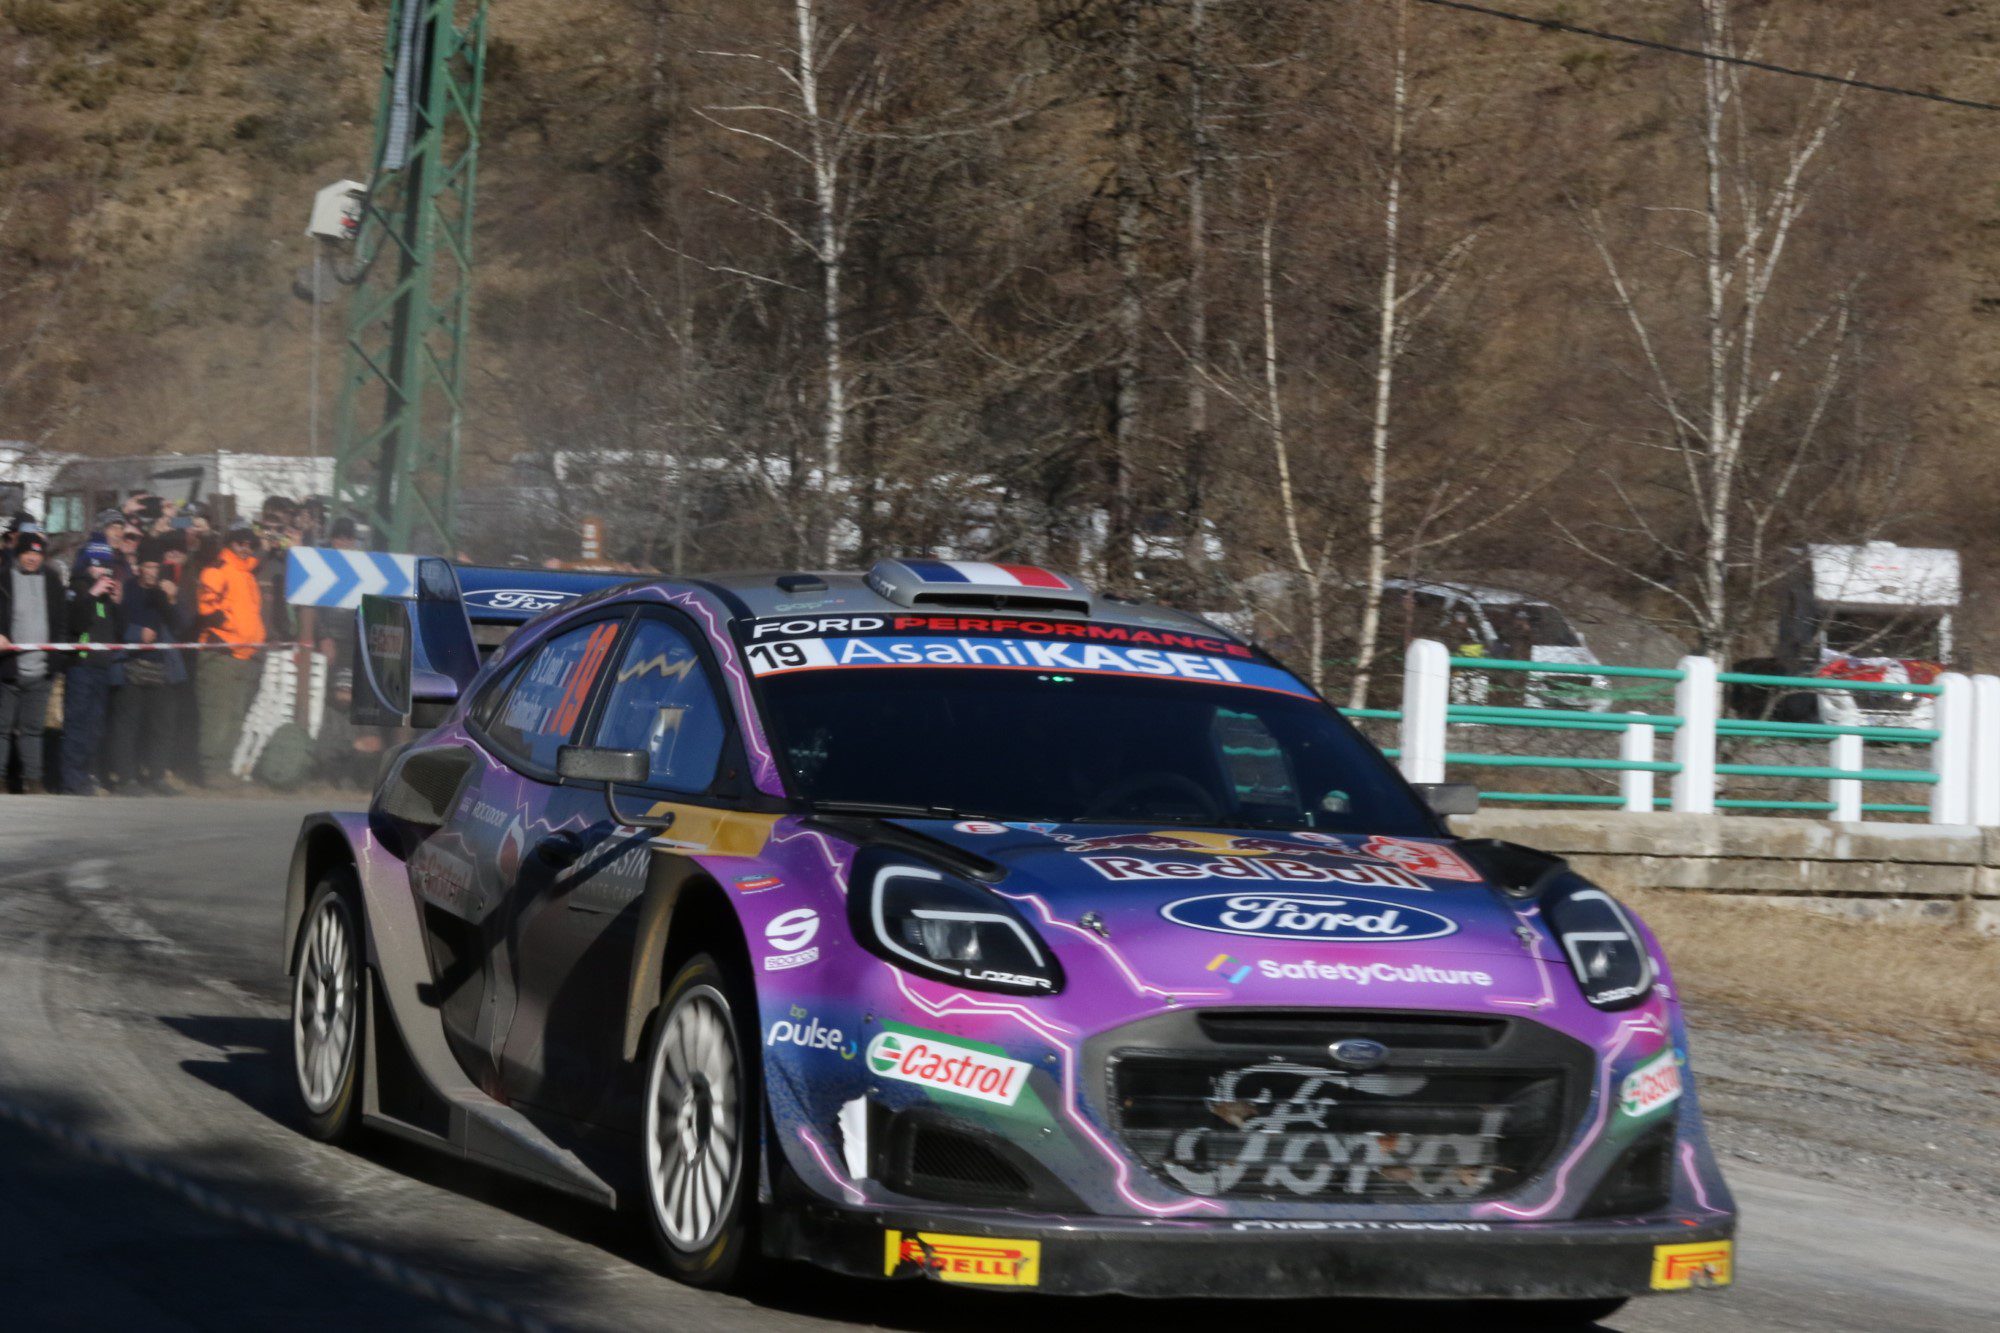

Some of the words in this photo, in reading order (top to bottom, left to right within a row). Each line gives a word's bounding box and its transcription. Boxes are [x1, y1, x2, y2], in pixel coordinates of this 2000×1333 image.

[748, 642, 808, 669] 19
[752, 617, 885, 639] FORD
[892, 617, 1254, 658] PERFORMANCE
[550, 623, 619, 737] 19
[1082, 855, 1270, 881] Red
[1252, 857, 1432, 891] Bull
[1219, 896, 1409, 934] Ford
[1257, 959, 1494, 986] SafetyCulture
[767, 1017, 843, 1051] pulse
[900, 1044, 1017, 1098] Castrol
[1162, 1062, 1506, 1197] Ford
